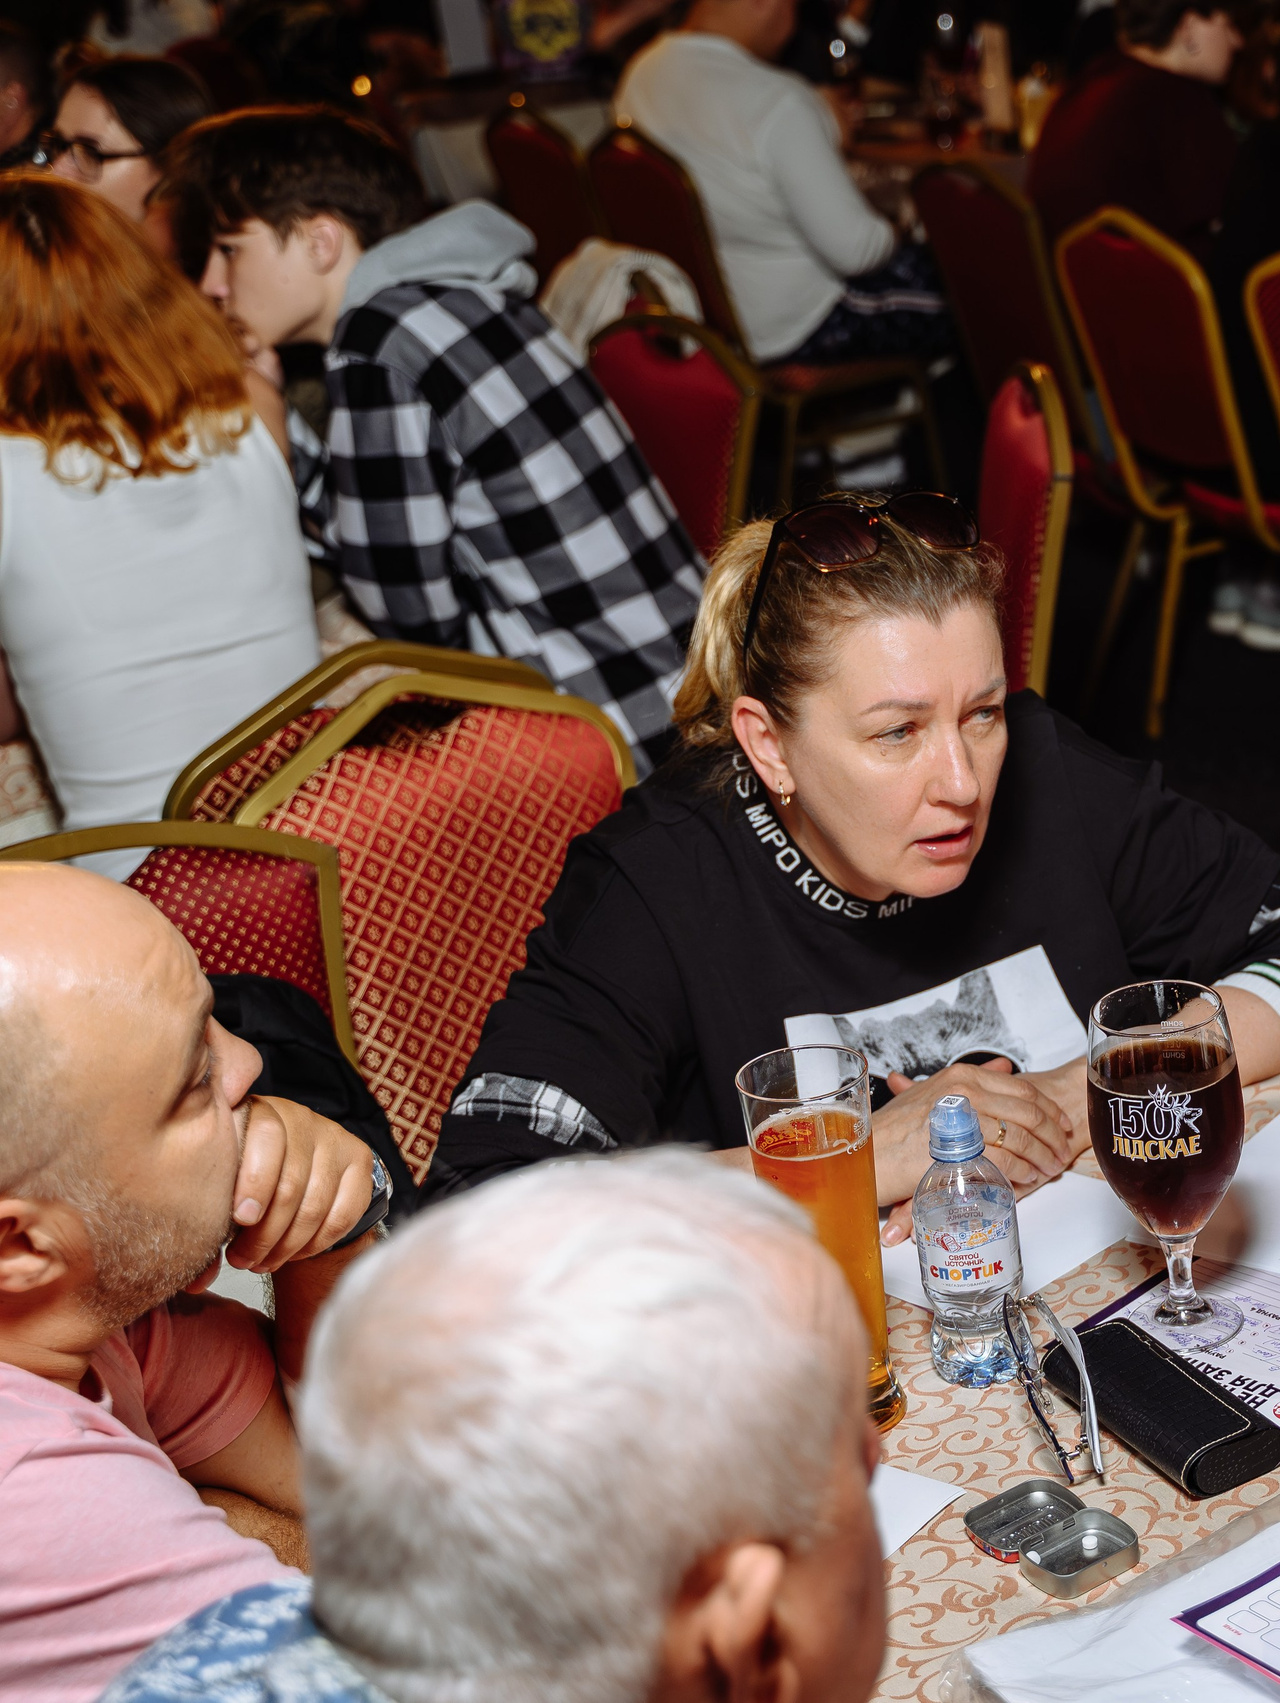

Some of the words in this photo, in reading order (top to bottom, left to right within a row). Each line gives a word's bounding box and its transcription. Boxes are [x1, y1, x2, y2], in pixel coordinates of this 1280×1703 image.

[745, 802, 801, 873] MIPO
[795, 868, 870, 919] KIDS
[1112, 1134, 1203, 1162] ЛІДСКАЕ
[944, 1258, 985, 1267] ИСТОЧНИК
[948, 1252, 979, 1261] СВЯТОЙ
[930, 1260, 1004, 1281] СПОРТИК
